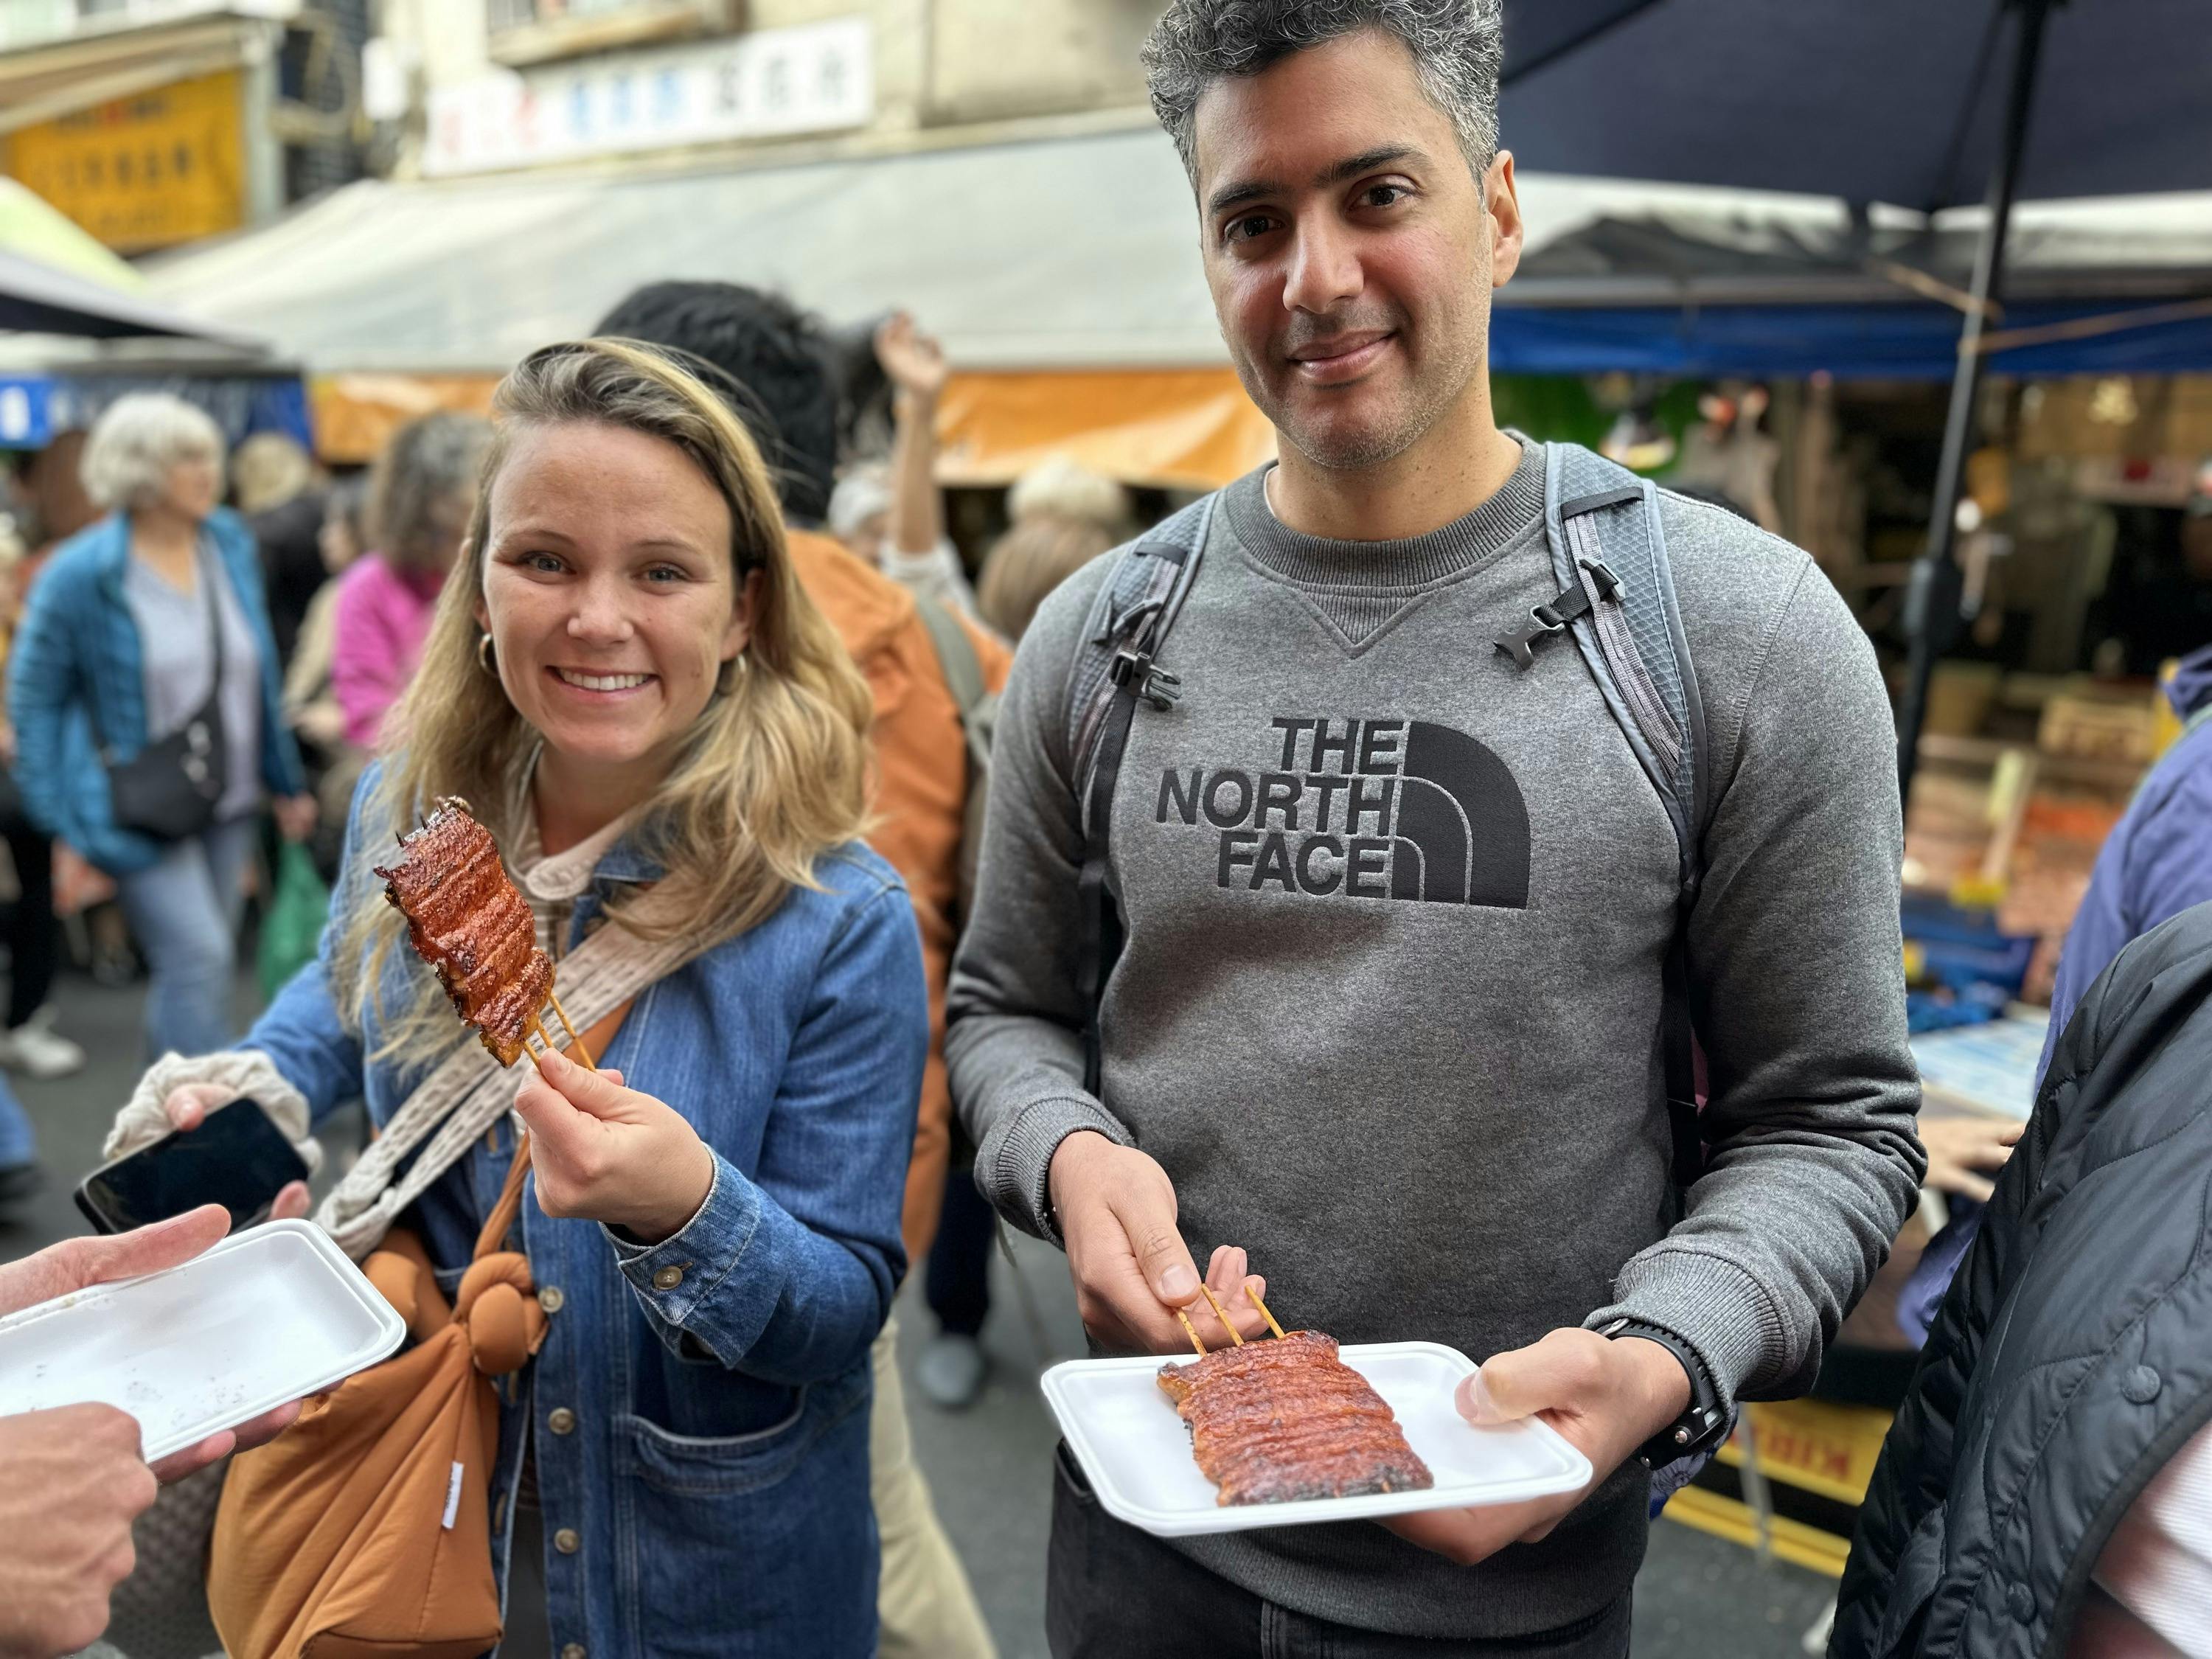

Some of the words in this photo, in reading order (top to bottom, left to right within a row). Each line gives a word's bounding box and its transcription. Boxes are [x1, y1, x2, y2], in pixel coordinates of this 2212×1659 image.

[1272, 717, 1404, 775] THE
[1155, 768, 1395, 836] NORTH
[1217, 831, 1390, 898] FACE
